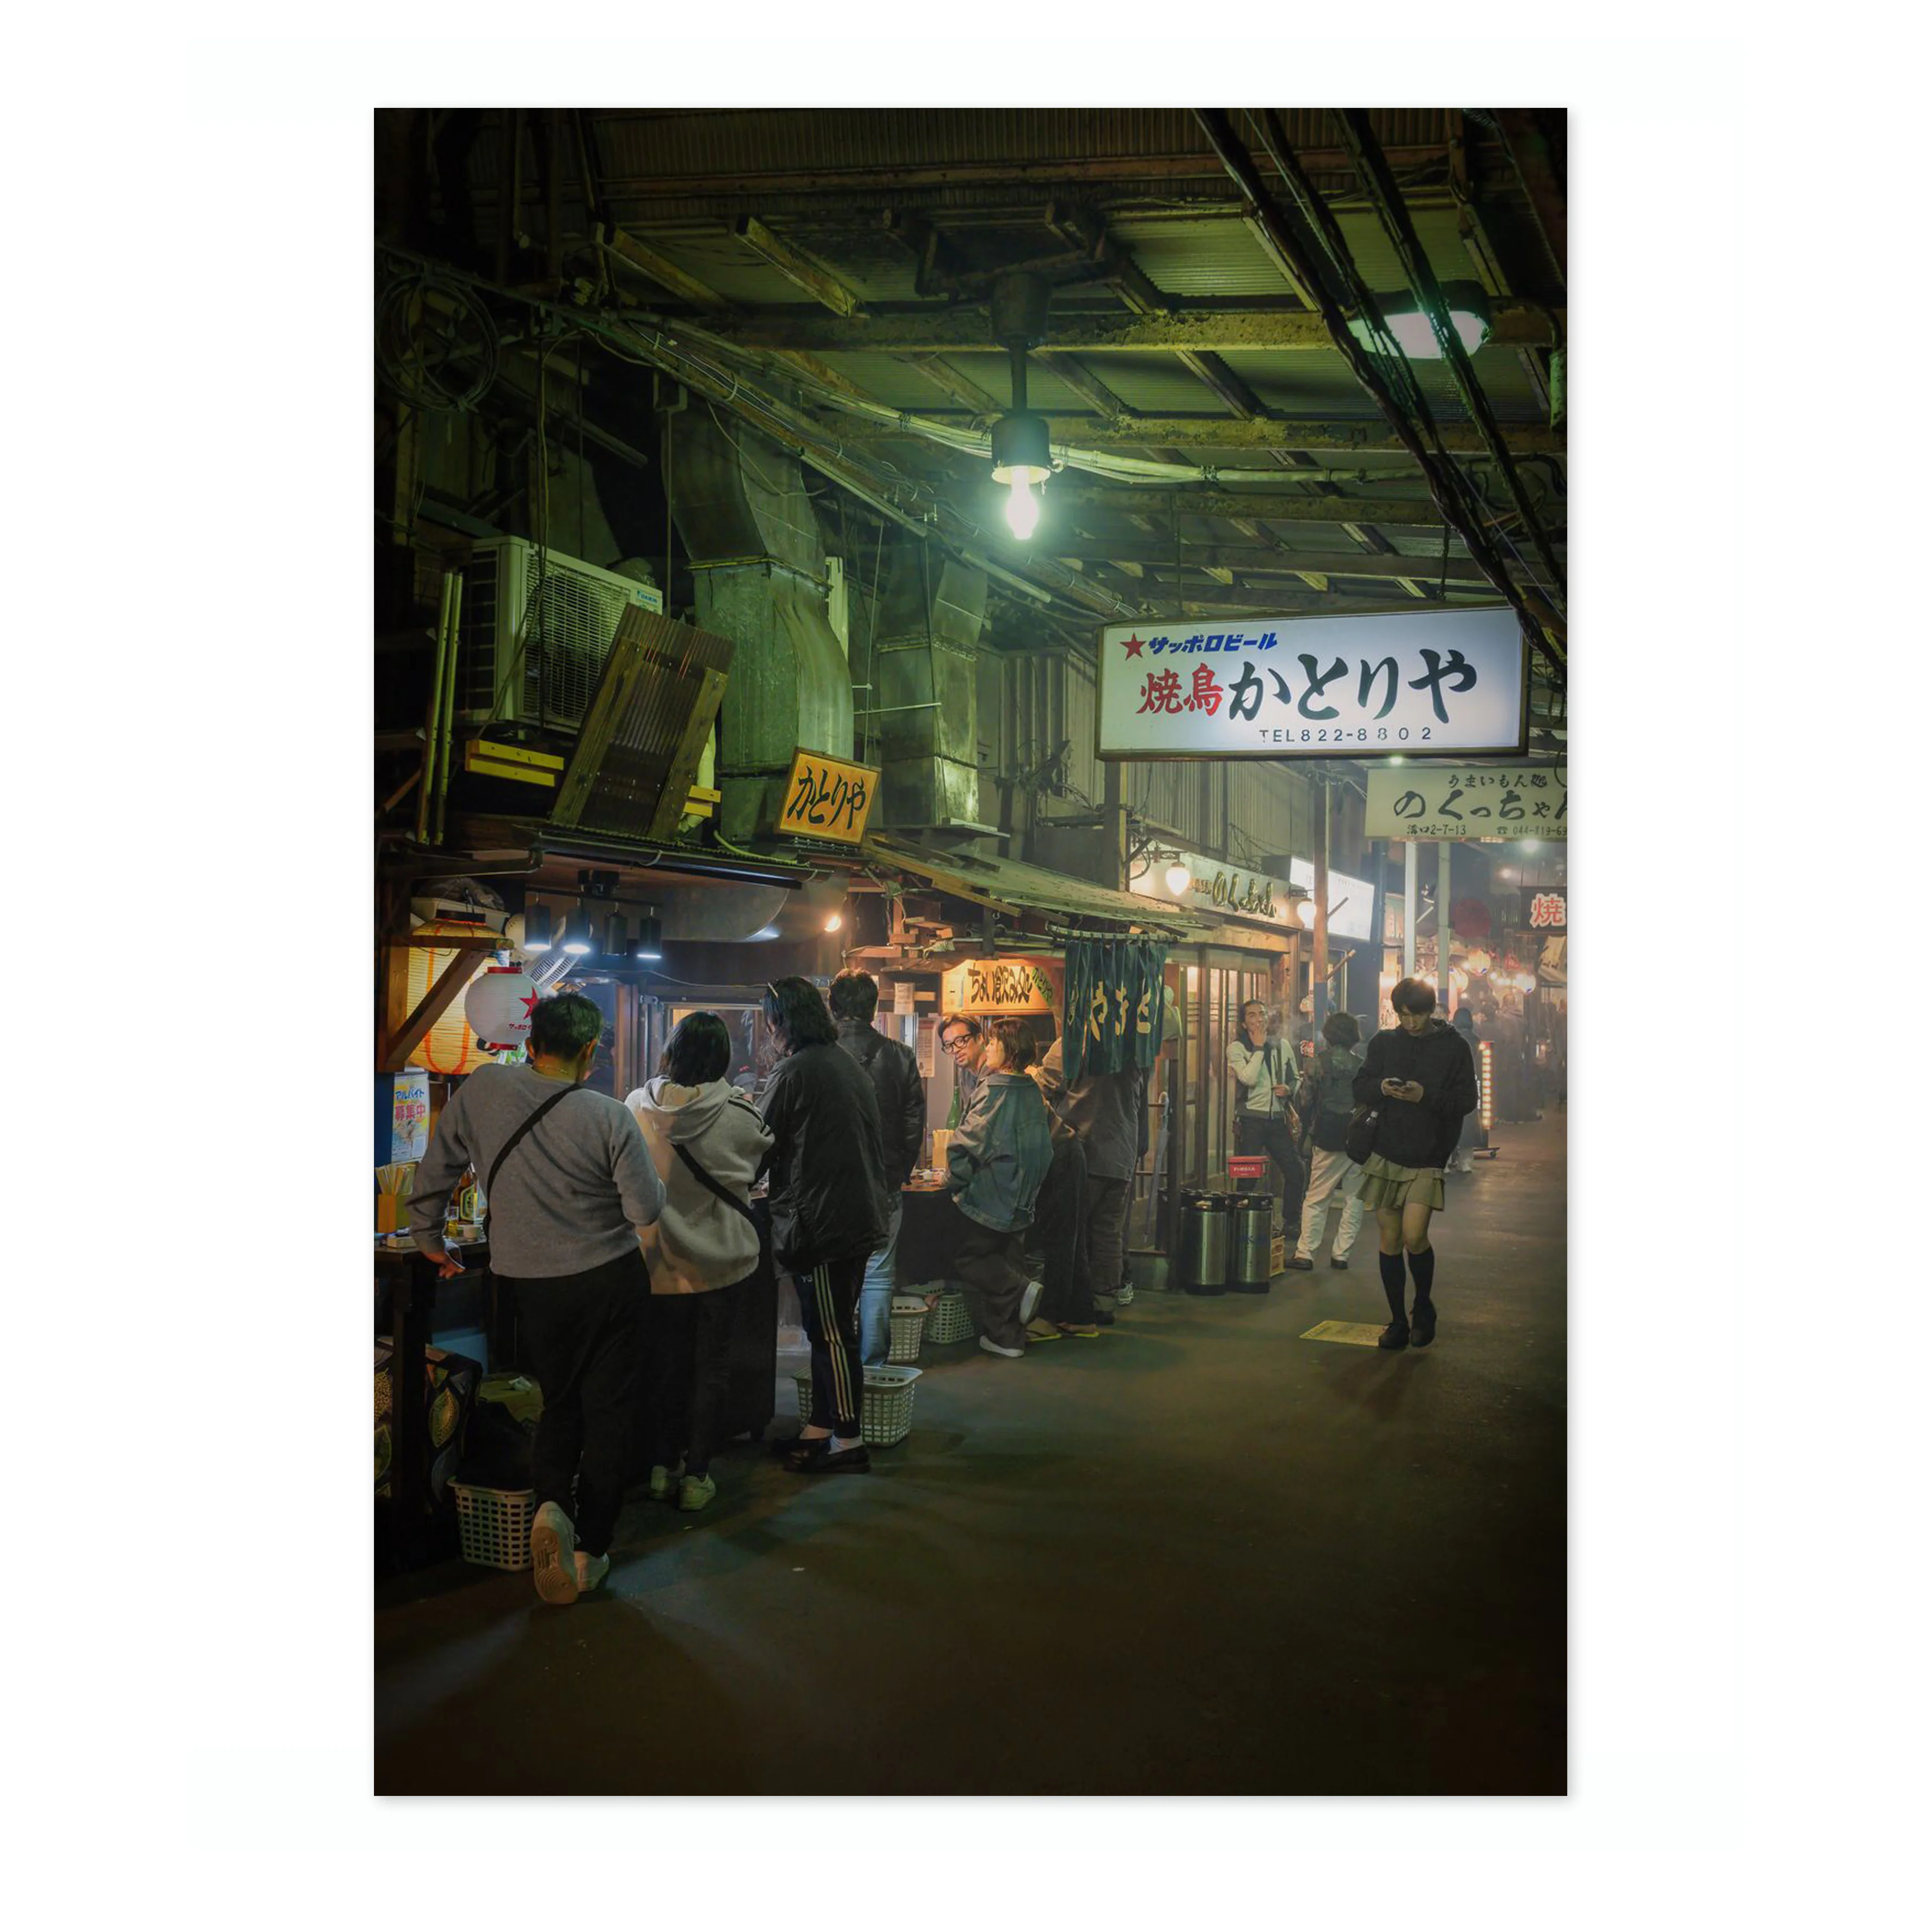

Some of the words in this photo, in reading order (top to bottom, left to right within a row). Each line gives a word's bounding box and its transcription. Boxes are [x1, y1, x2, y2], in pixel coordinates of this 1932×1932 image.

[1148, 632, 1278, 655] サッポロビール
[1136, 662, 1224, 716] 焼鳥
[1229, 648, 1477, 723] かとりや
[787, 765, 866, 830] かとりや
[1532, 895, 1565, 926] 焼
[395, 1102, 425, 1121] 募集中
